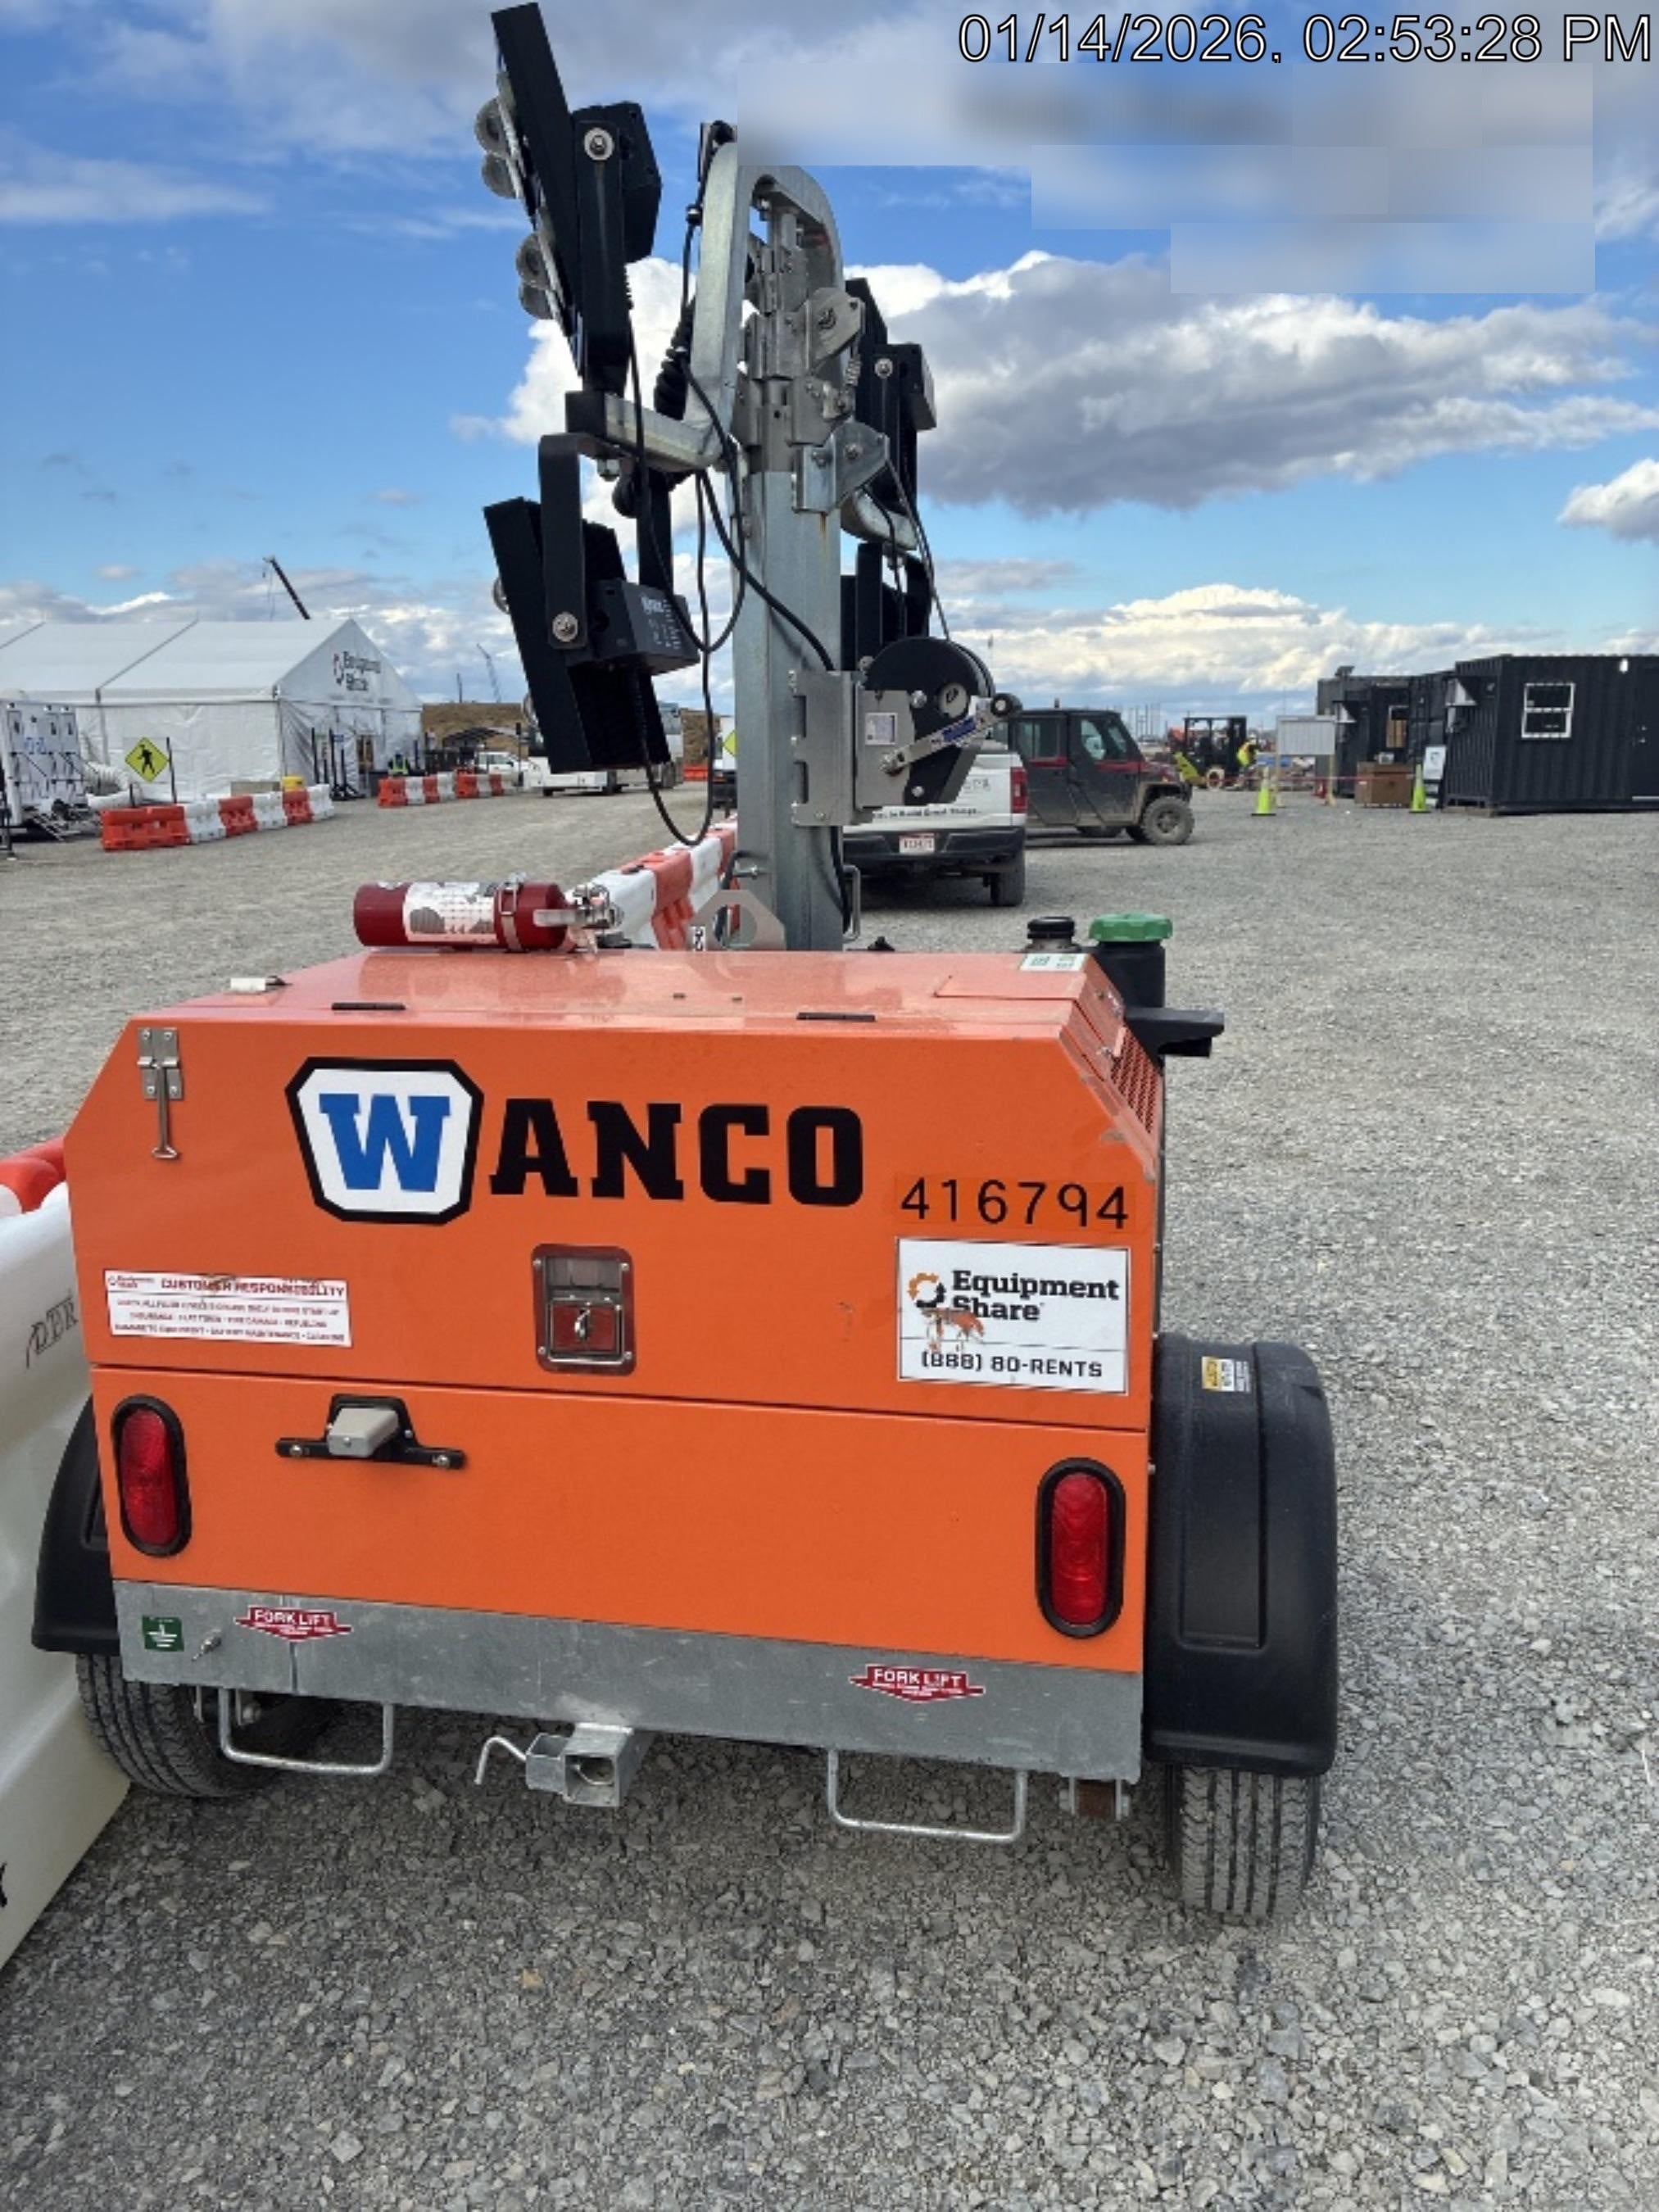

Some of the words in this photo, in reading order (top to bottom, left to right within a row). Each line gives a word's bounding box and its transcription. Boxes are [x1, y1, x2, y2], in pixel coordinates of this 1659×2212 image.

[900, 1176, 1129, 1230] 416794
[161, 1278, 232, 1292] CUSTOMER
[235, 1281, 345, 1297] RESPONSIBILITY
[952, 1269, 1120, 1301] Equipment
[952, 1294, 1041, 1321] Share
[921, 1350, 982, 1371] (888)
[990, 1356, 1103, 1378] 80-RENTS
[254, 1608, 296, 1624] FORK
[299, 1612, 331, 1626] LIFT
[873, 1668, 920, 1684] FORK
[923, 1672, 962, 1687] LIFT
